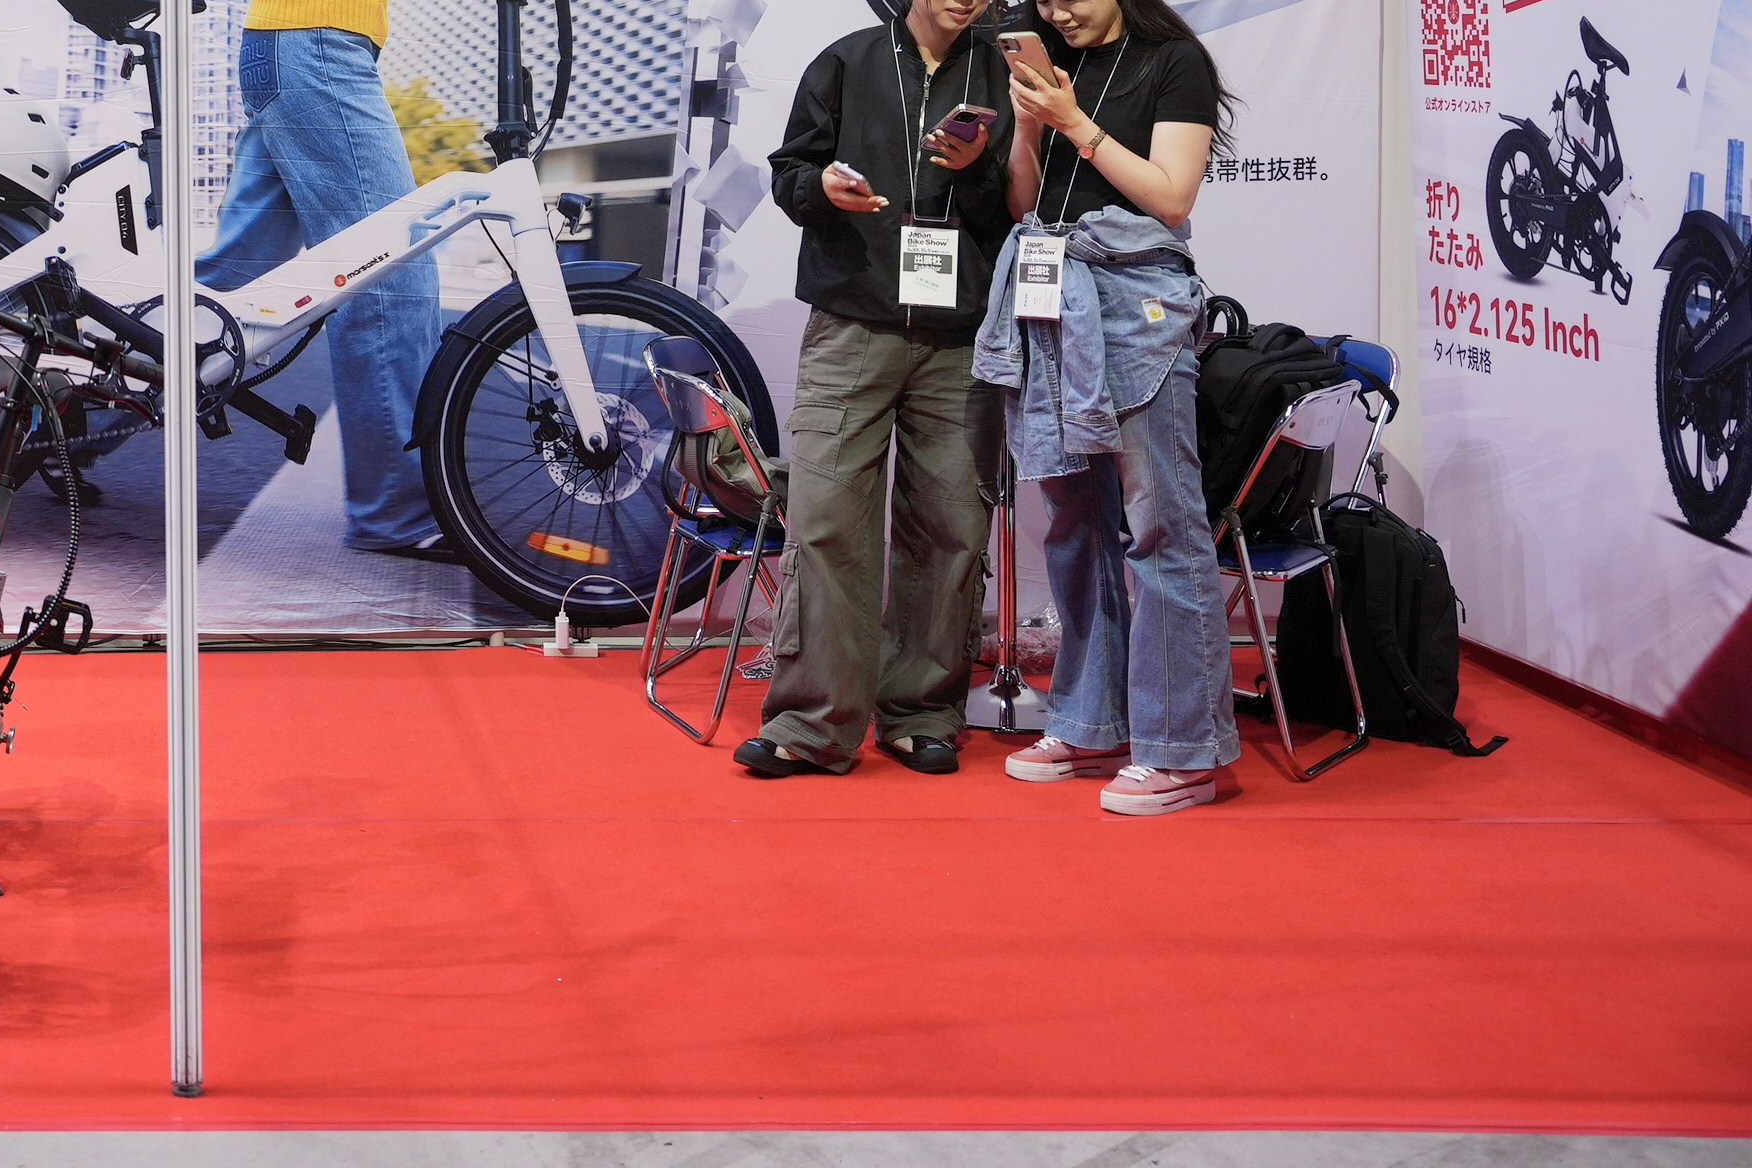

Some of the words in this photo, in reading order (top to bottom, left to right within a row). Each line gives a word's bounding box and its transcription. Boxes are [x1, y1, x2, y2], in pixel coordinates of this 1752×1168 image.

[1425, 96, 1491, 114] 公式オンラインストア
[1426, 179, 1461, 222] 折り
[1428, 225, 1484, 272] たたみ
[1544, 307, 1600, 362] Inch
[1433, 338, 1492, 375] タイヤ規格
